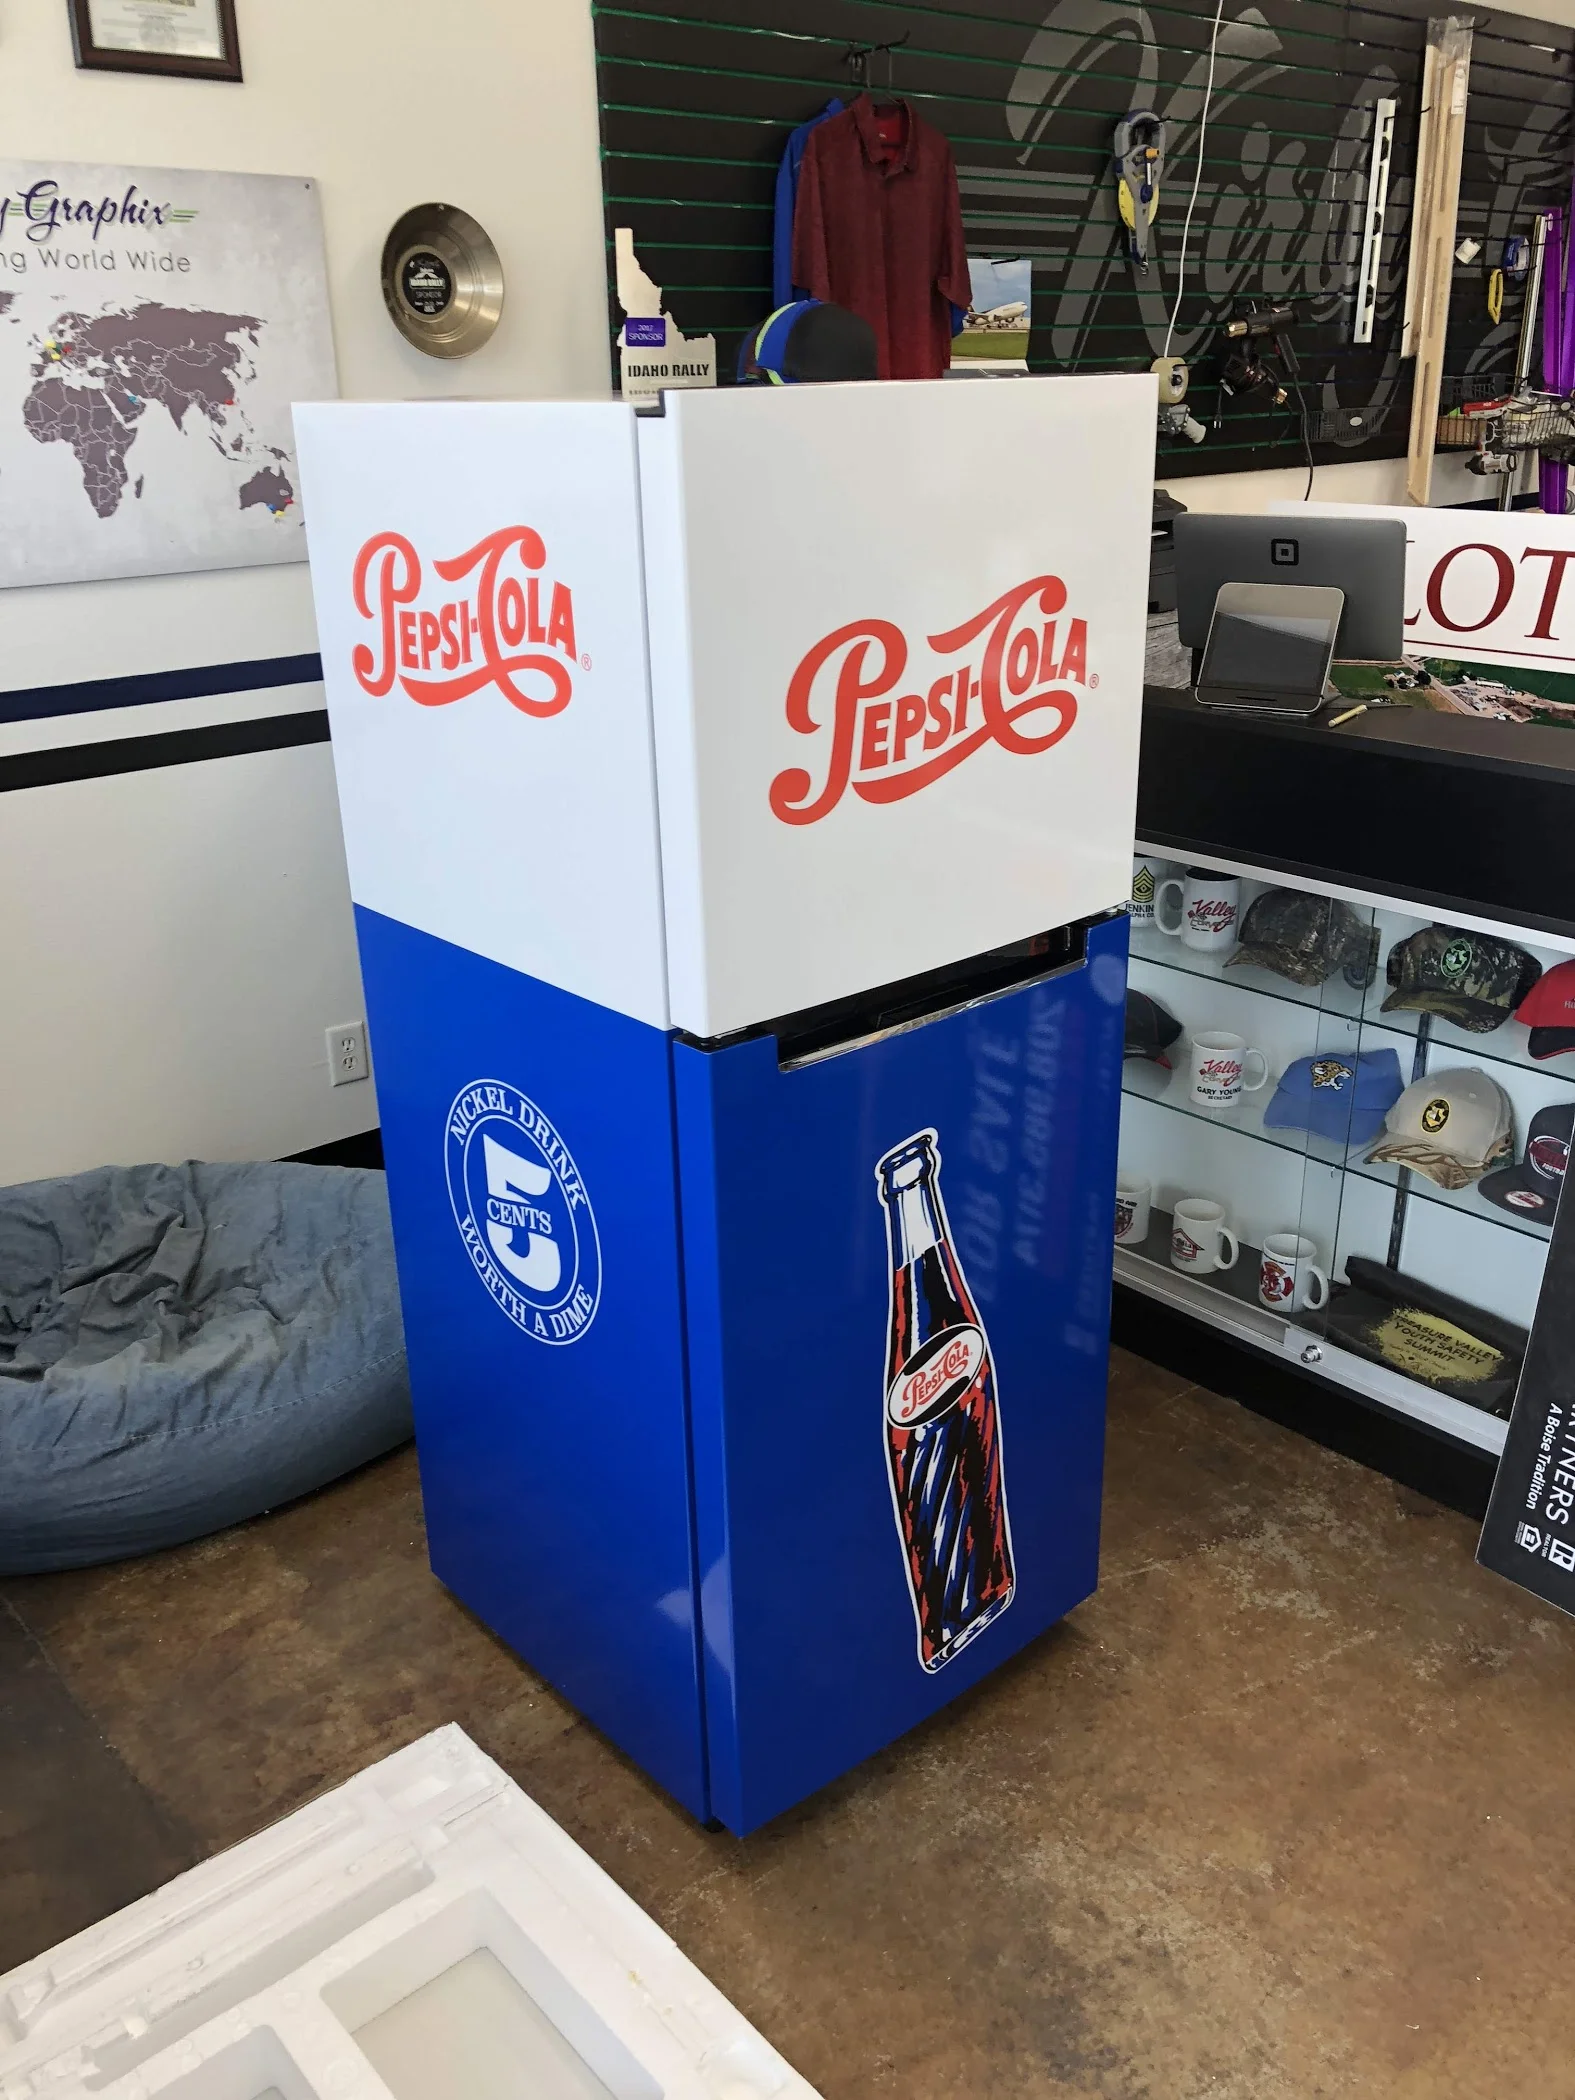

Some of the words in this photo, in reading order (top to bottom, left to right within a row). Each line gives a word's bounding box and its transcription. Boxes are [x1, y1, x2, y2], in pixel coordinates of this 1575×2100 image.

[17, 180, 172, 242] Graphix
[38, 248, 116, 271] World
[127, 250, 192, 273] Wide
[628, 332, 664, 341] SPONSOR
[627, 365, 668, 378] IDAHO
[672, 363, 710, 377] RALLY
[1404, 540, 1575, 641] OT
[1192, 899, 1237, 932] Valley
[1203, 1059, 1242, 1087] Valley
[1197, 1086, 1217, 1096] GARY
[451, 1086, 513, 1146] NICKEL
[519, 1099, 587, 1211] DRINK
[486, 1198, 553, 1235] CENTS
[460, 1213, 527, 1326] WORTH
[534, 1310, 549, 1338] A
[549, 1284, 593, 1339] DIME
[1394, 1314, 1453, 1342] TREASURE
[1455, 1340, 1502, 1361] VALLEY
[1394, 1322, 1437, 1344] YOUTH
[1437, 1341, 1485, 1365] SAFETY
[1403, 1338, 1456, 1362] SUMMIT
[1550, 1402, 1563, 1415] A
[1540, 1415, 1561, 1452] Boise
[1525, 1453, 1551, 1510] Tradition
[1540, 1533, 1552, 1558] REALTOR
